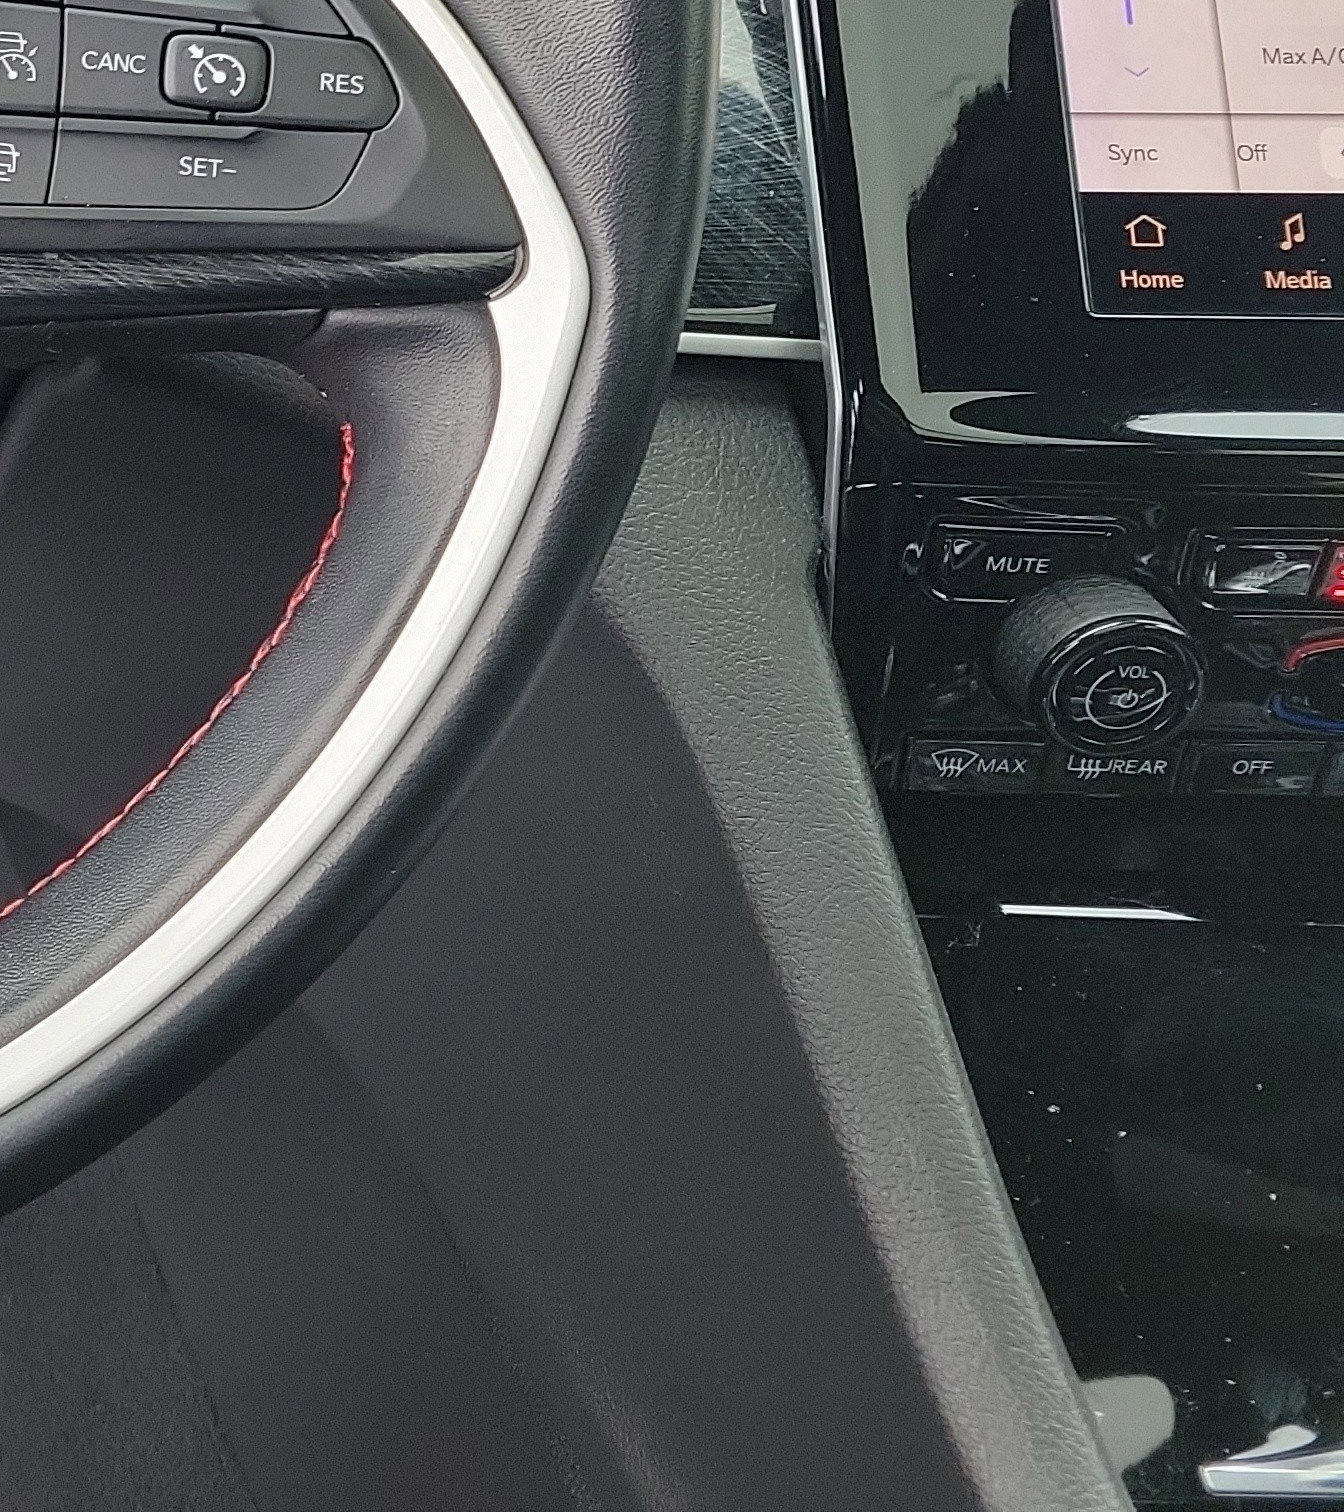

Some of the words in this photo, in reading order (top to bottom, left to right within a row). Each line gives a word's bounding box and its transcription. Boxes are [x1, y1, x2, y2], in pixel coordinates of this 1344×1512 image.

[81, 51, 147, 74] CANC
[1262, 47, 1308, 65] Max
[319, 72, 365, 95] RES
[1108, 143, 1159, 165] Sync
[1236, 143, 1268, 162] Off
[1120, 269, 1185, 289] Home
[1264, 270, 1332, 290] Media
[985, 555, 1052, 574] MUTE
[1118, 664, 1151, 680] VOL
[977, 758, 1027, 774] MAX
[1112, 759, 1168, 775] REAR
[1231, 759, 1275, 775] OFF
